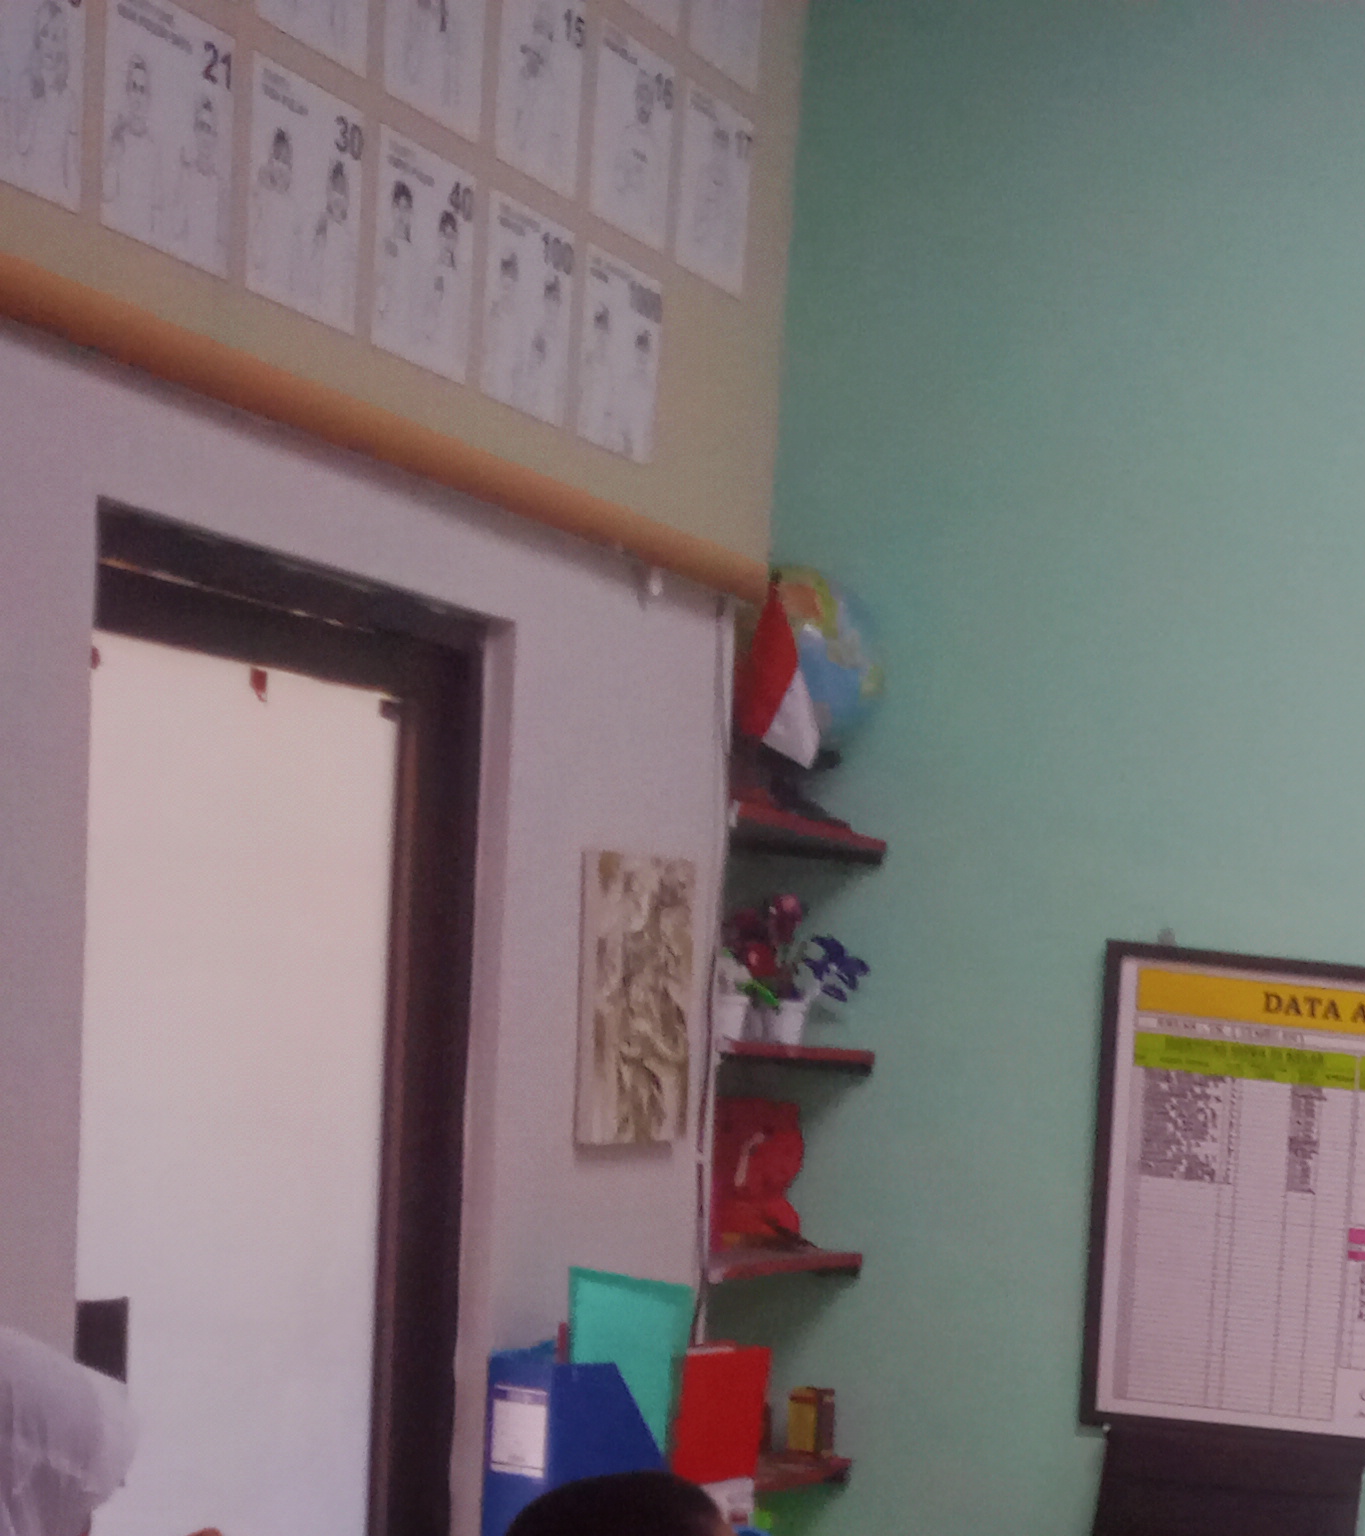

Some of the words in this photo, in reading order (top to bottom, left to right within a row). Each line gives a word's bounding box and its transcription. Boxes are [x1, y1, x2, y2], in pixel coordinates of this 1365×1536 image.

[564, 9, 585, 49] 15
[203, 41, 232, 90] 21
[333, 115, 364, 161] 30
[1263, 991, 1342, 1022] DATA
